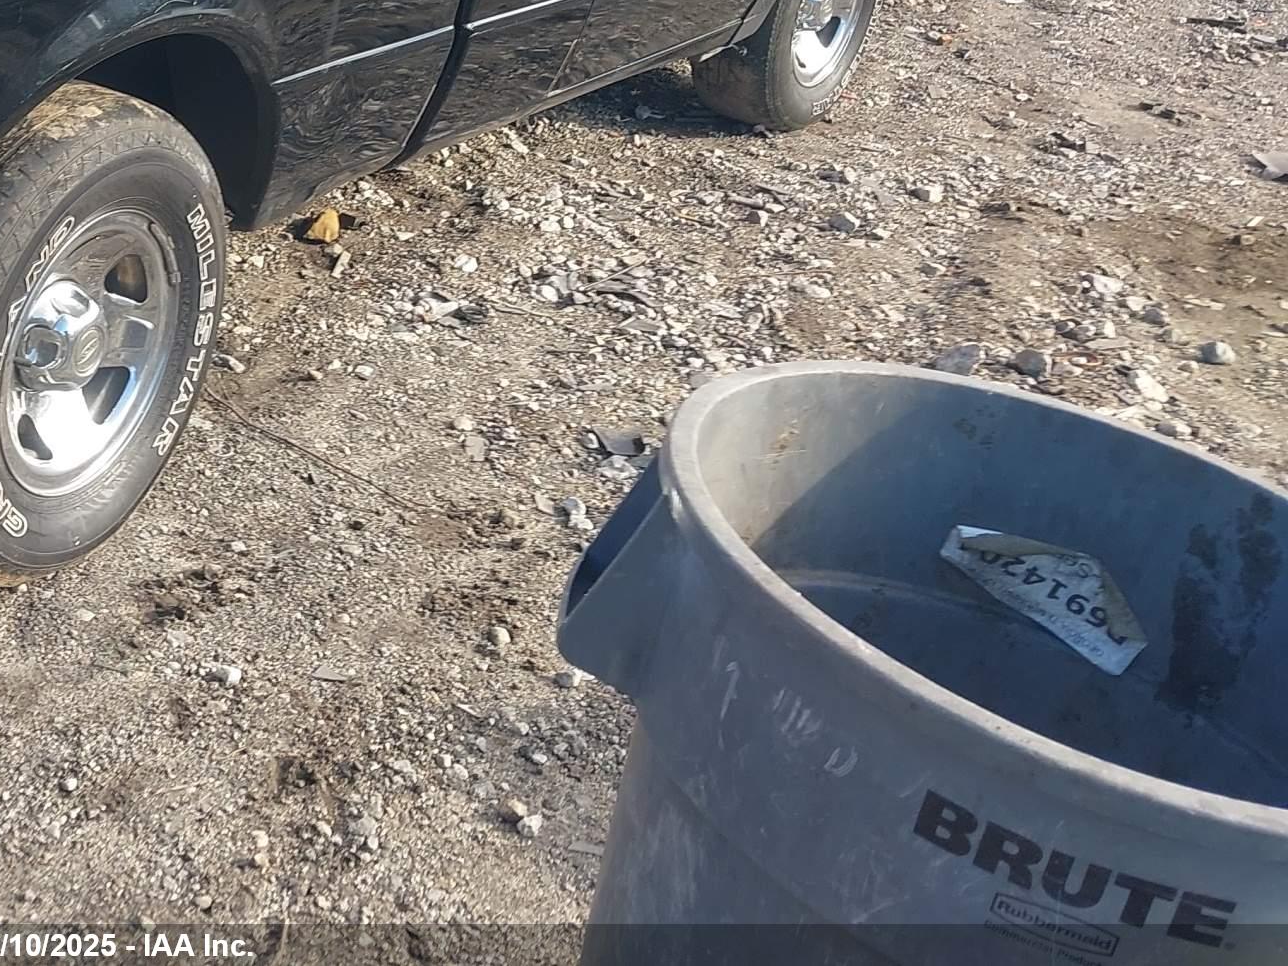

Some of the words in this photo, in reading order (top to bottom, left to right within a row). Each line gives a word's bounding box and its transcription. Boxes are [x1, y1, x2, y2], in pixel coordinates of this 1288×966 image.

[152, 203, 217, 456] MILESTAR
[912, 788, 1238, 949] BRUTE
[996, 899, 1112, 951] Rubbermaid
